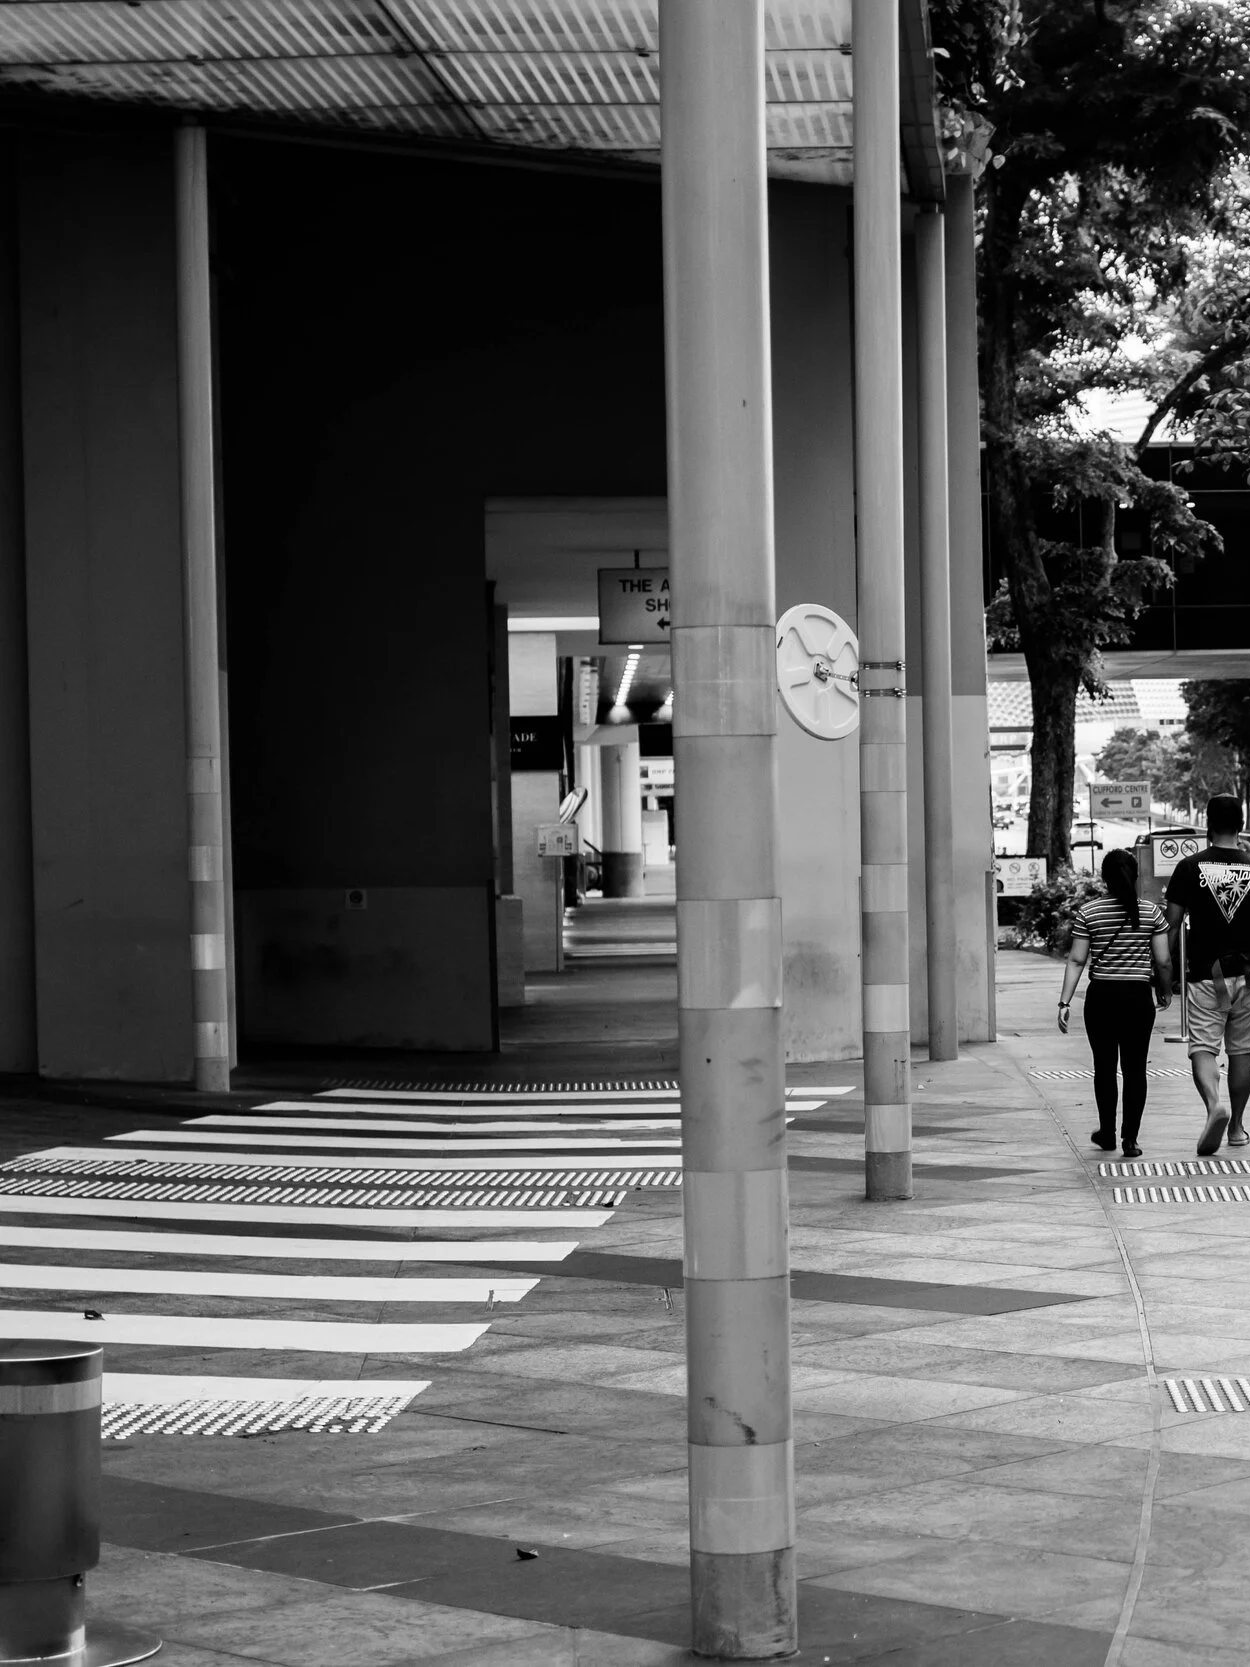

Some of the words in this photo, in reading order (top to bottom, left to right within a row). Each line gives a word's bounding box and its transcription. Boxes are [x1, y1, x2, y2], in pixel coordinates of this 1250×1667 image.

[619, 579, 653, 593] THE
[645, 598, 670, 613] SH
[1092, 784, 1123, 794] CLIFFORD
[1124, 783, 1149, 793] CENTRE
